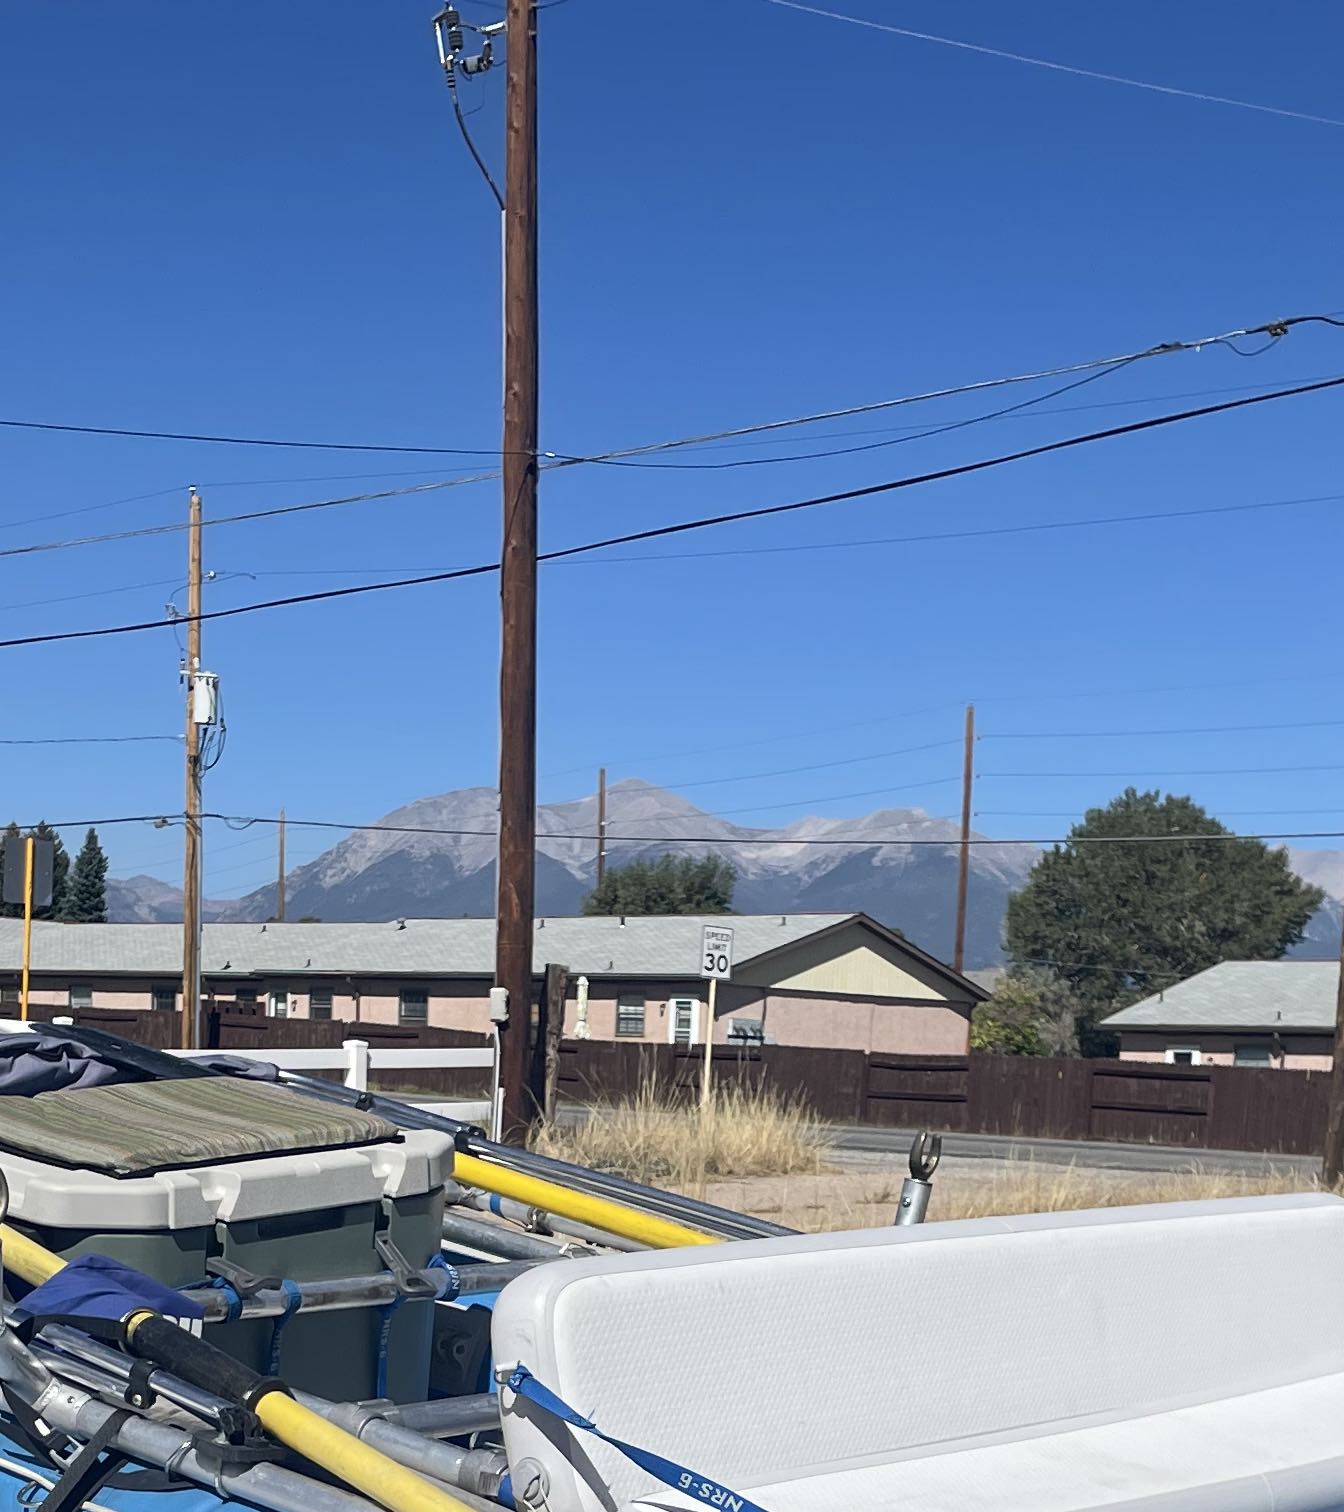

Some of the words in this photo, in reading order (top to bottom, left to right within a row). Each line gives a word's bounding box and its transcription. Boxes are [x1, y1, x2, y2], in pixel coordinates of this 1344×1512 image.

[706, 931, 731, 942] SPEED
[707, 942, 727, 952] LIMIT
[704, 953, 728, 973] 30
